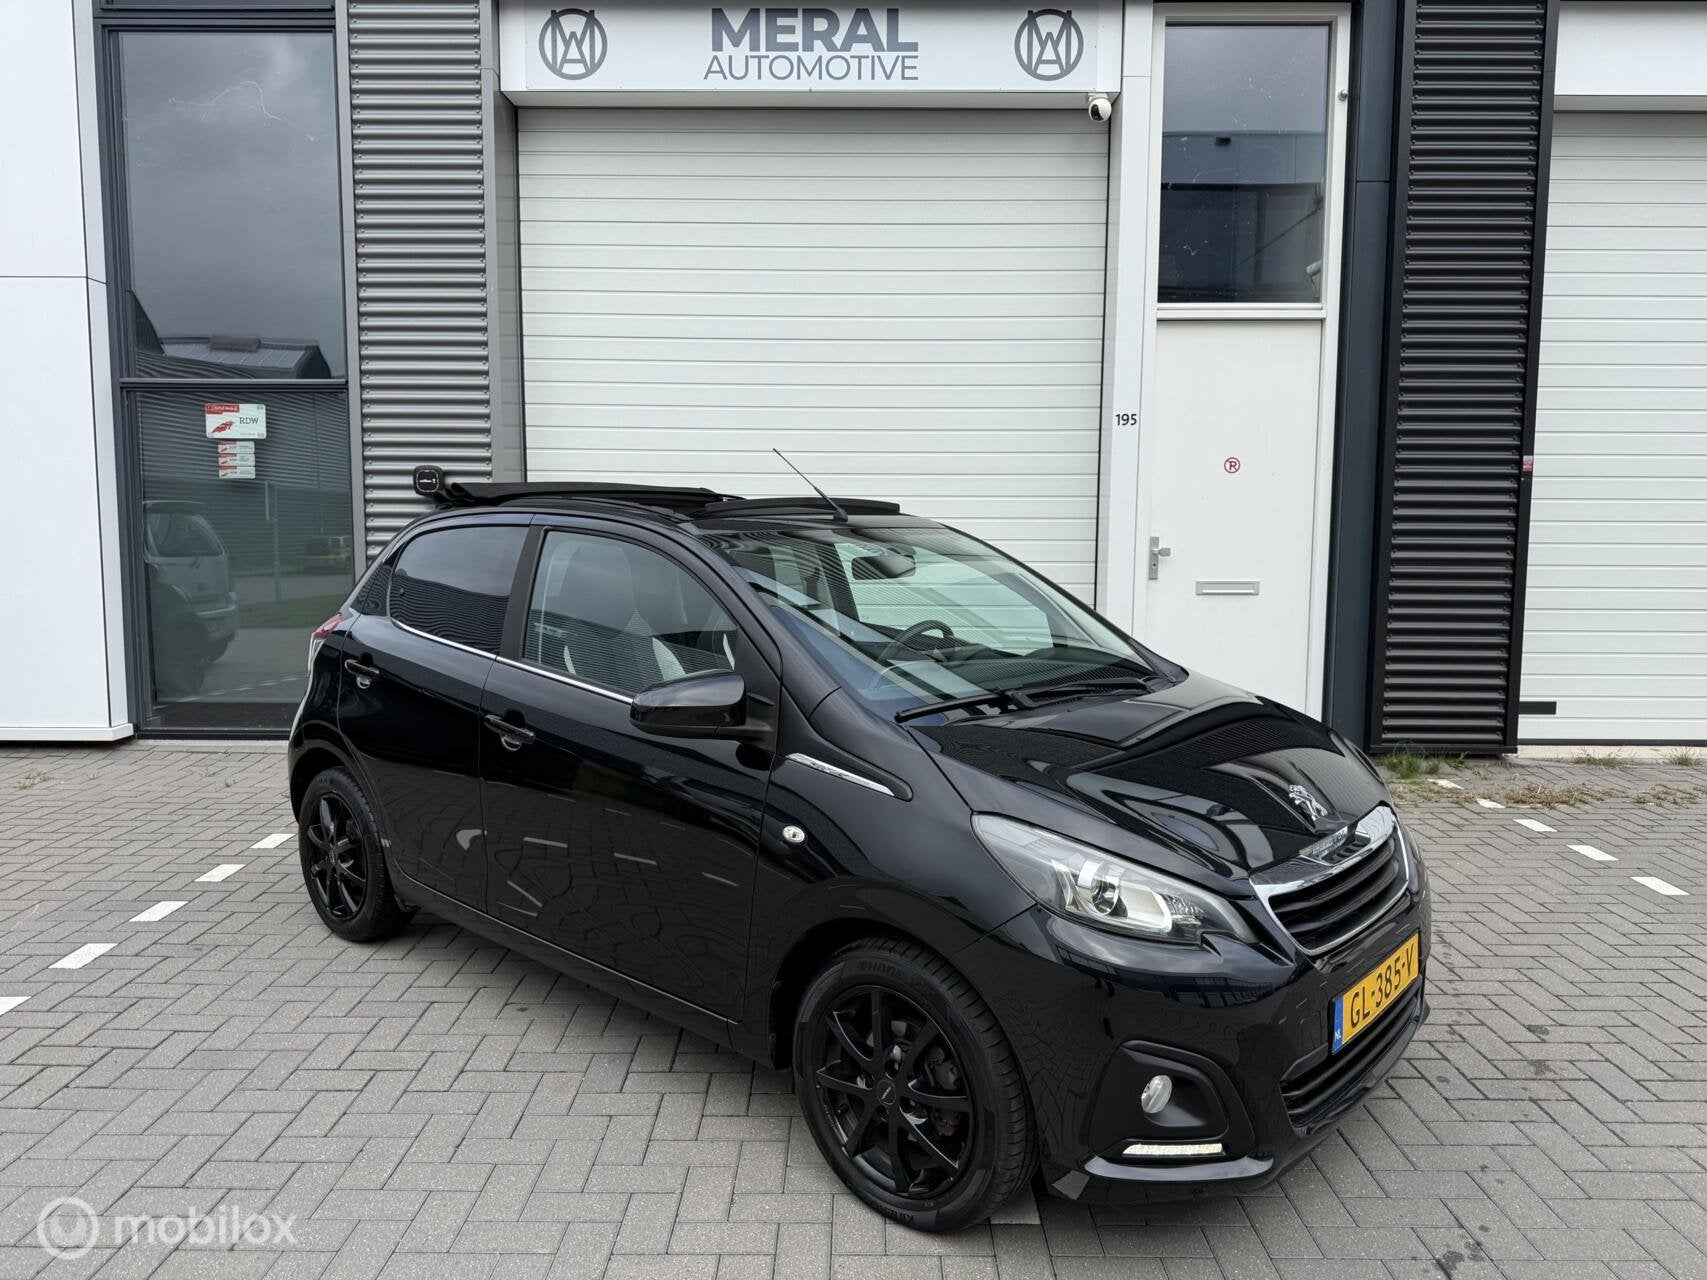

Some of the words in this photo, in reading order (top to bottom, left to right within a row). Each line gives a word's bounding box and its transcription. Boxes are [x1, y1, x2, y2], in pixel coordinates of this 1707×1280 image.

[711, 8, 918, 52] MERAL
[703, 55, 919, 80] AUTOMOTIVE
[1115, 413, 1138, 426] 195
[1350, 944, 1414, 1029] GL-385-V
[1335, 1029, 1341, 1041] NL
